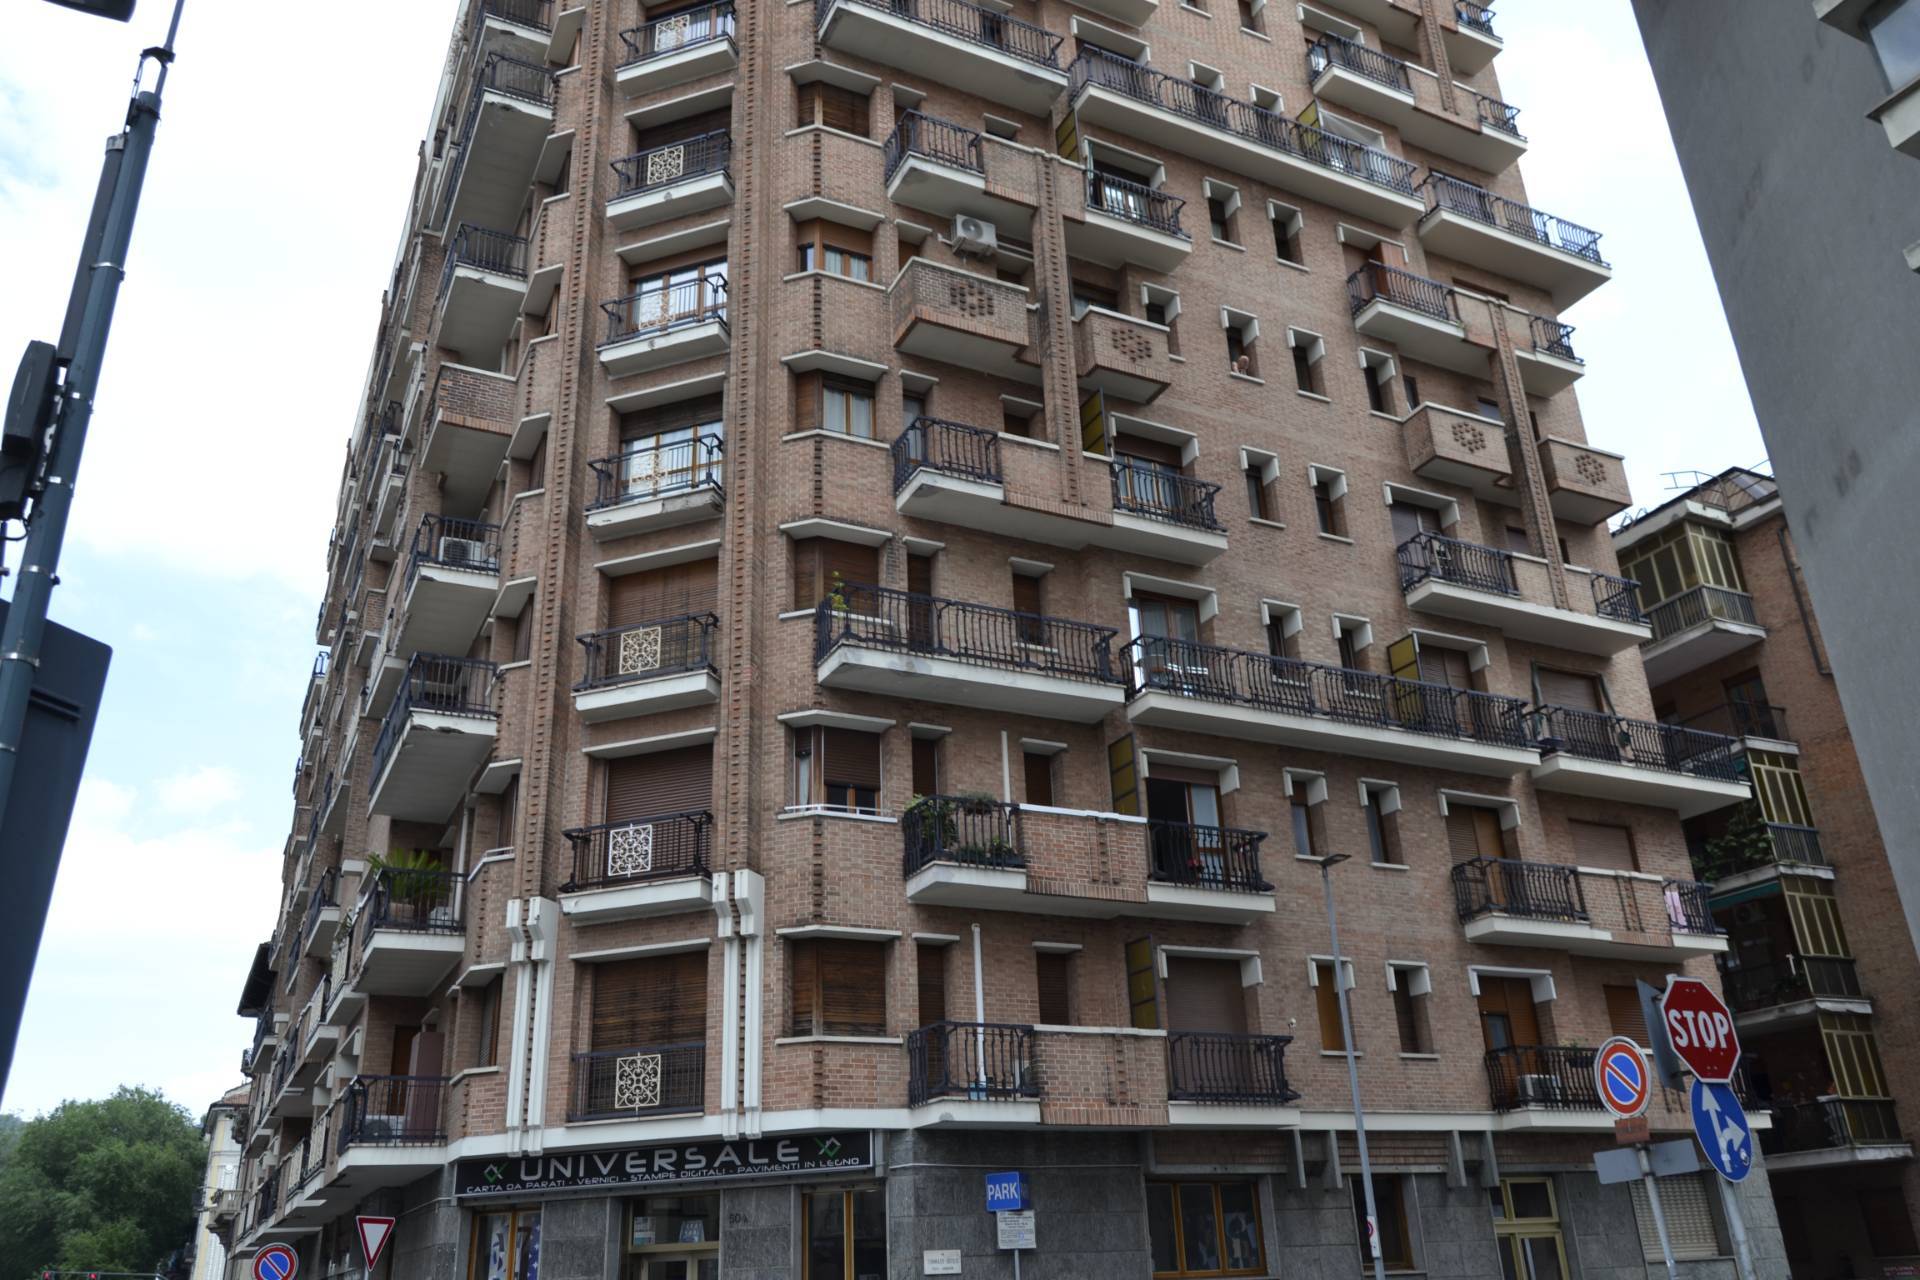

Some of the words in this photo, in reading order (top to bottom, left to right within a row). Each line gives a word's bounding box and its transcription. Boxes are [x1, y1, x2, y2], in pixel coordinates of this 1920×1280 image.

[1668, 1008, 1729, 1049] STOP
[466, 1183, 501, 1194] CARTA
[506, 1183, 522, 1191] DA
[526, 1179, 565, 1189] PARATI
[577, 1175, 619, 1185] VERNICI
[630, 1171, 676, 1182] STAMPE
[680, 1168, 726, 1178] DIGITALI
[737, 1162, 800, 1174] PAVIMENTI
[804, 1161, 816, 1169] IN
[820, 1157, 860, 1167] LEGNO
[520, 1140, 799, 1181] UNIVERSALE
[987, 1182, 1018, 1201] PARK
